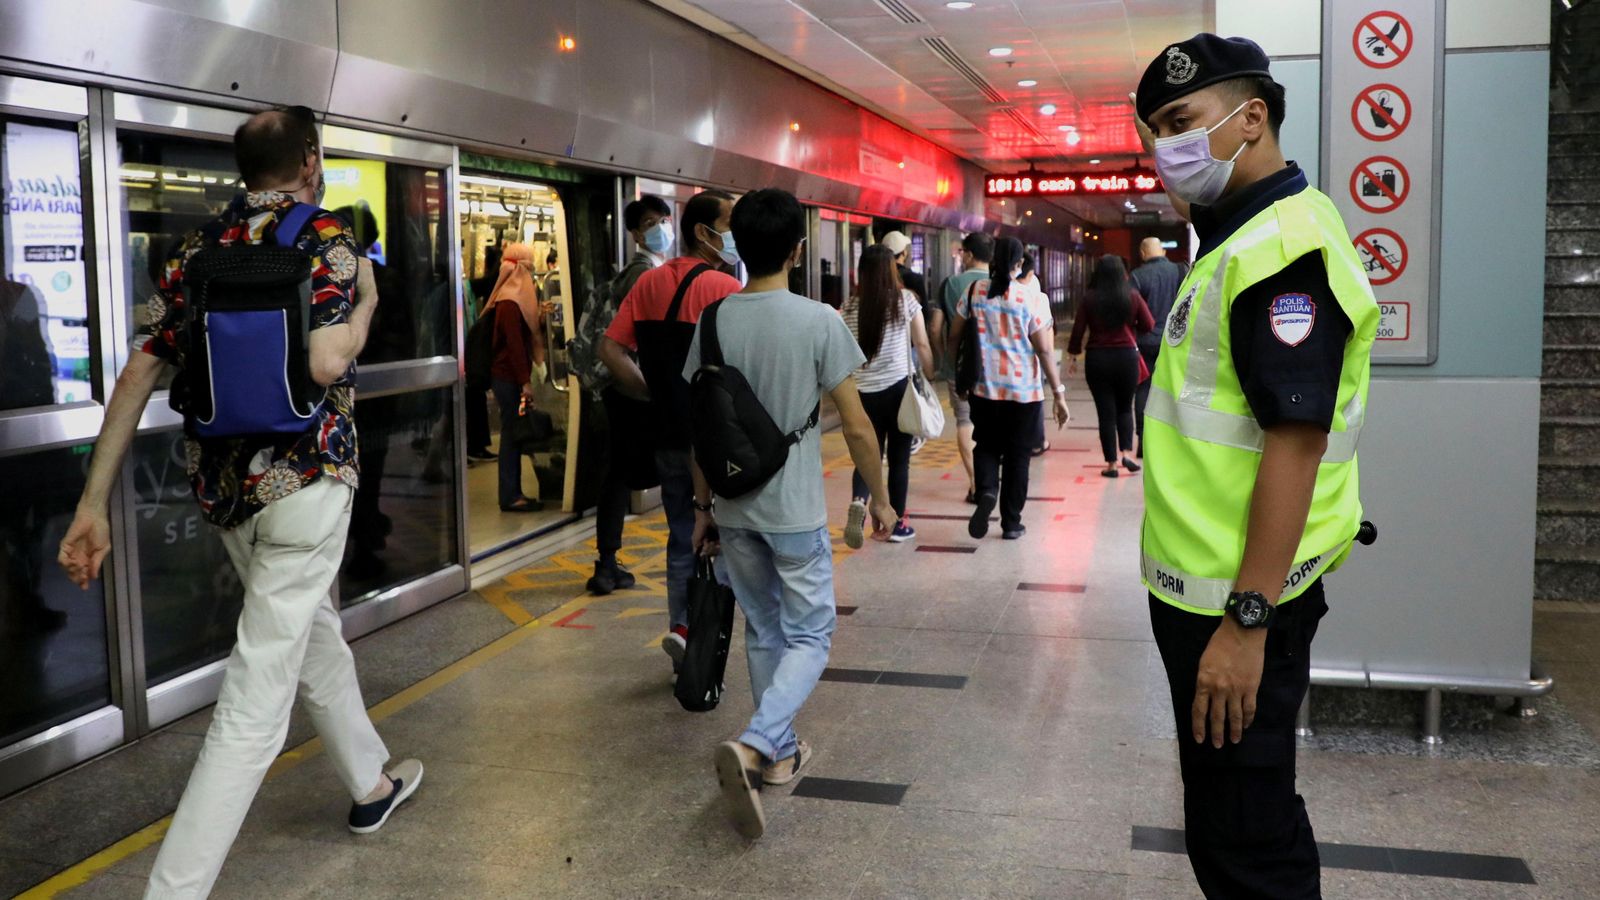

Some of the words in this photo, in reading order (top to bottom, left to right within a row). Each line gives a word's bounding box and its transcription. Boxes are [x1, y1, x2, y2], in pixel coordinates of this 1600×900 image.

[1082, 175, 1129, 191] train
[1134, 174, 1156, 189] to
[1280, 297, 1304, 305] POLIS
[1272, 305, 1311, 314] BANTUAN
[1379, 305, 1397, 315] DA
[1156, 569, 1185, 596] PDRM
